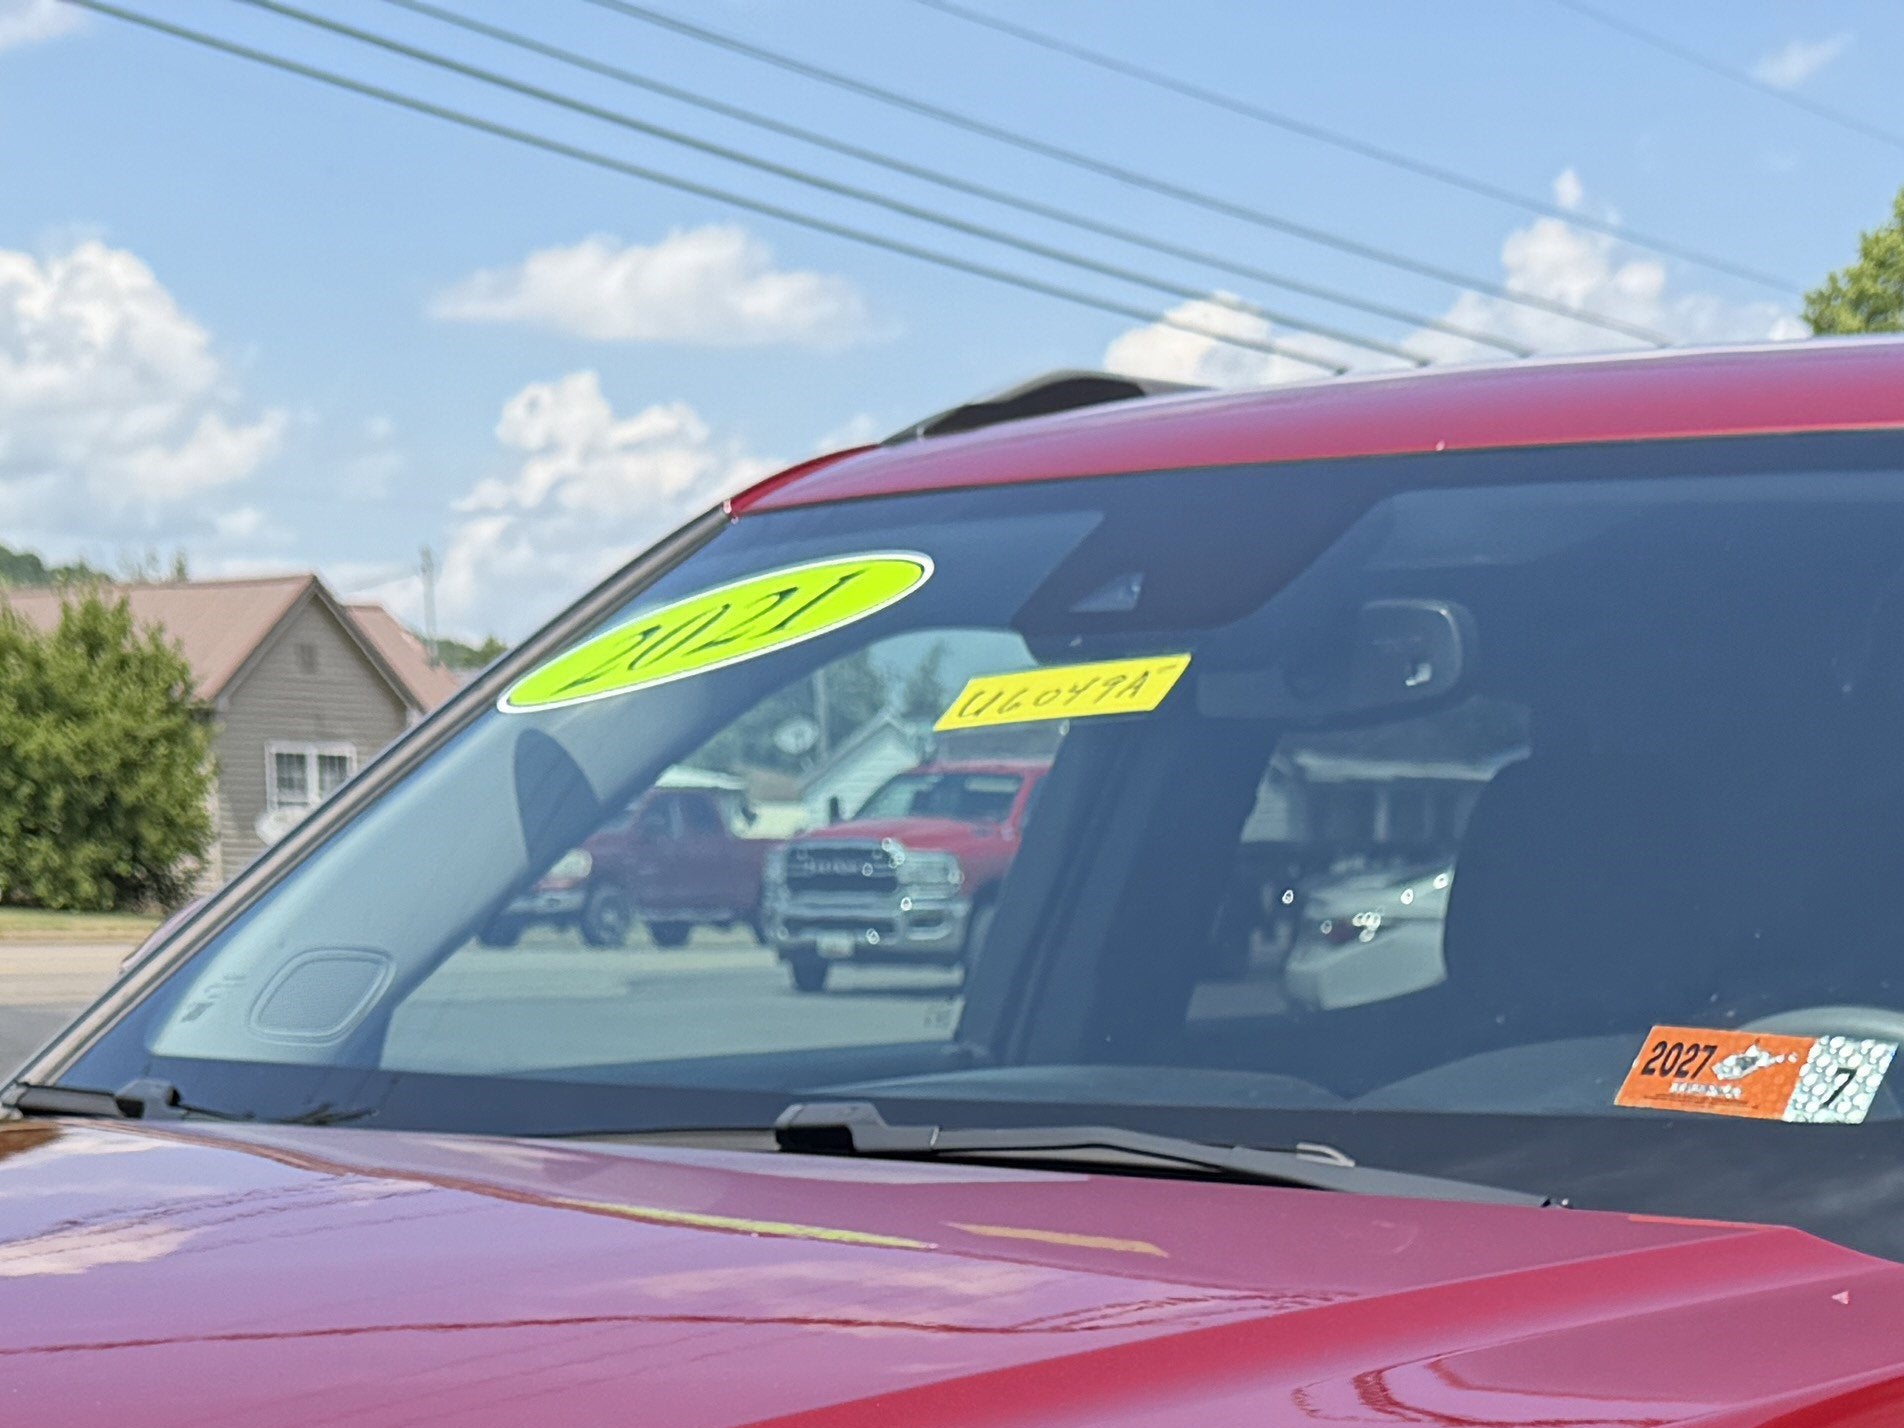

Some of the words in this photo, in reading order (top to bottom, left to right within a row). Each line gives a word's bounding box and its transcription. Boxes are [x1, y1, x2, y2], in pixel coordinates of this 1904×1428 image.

[550, 567, 872, 697] 2021
[1640, 1040, 1718, 1080] 2027
[1821, 1066, 1856, 1108] 7
